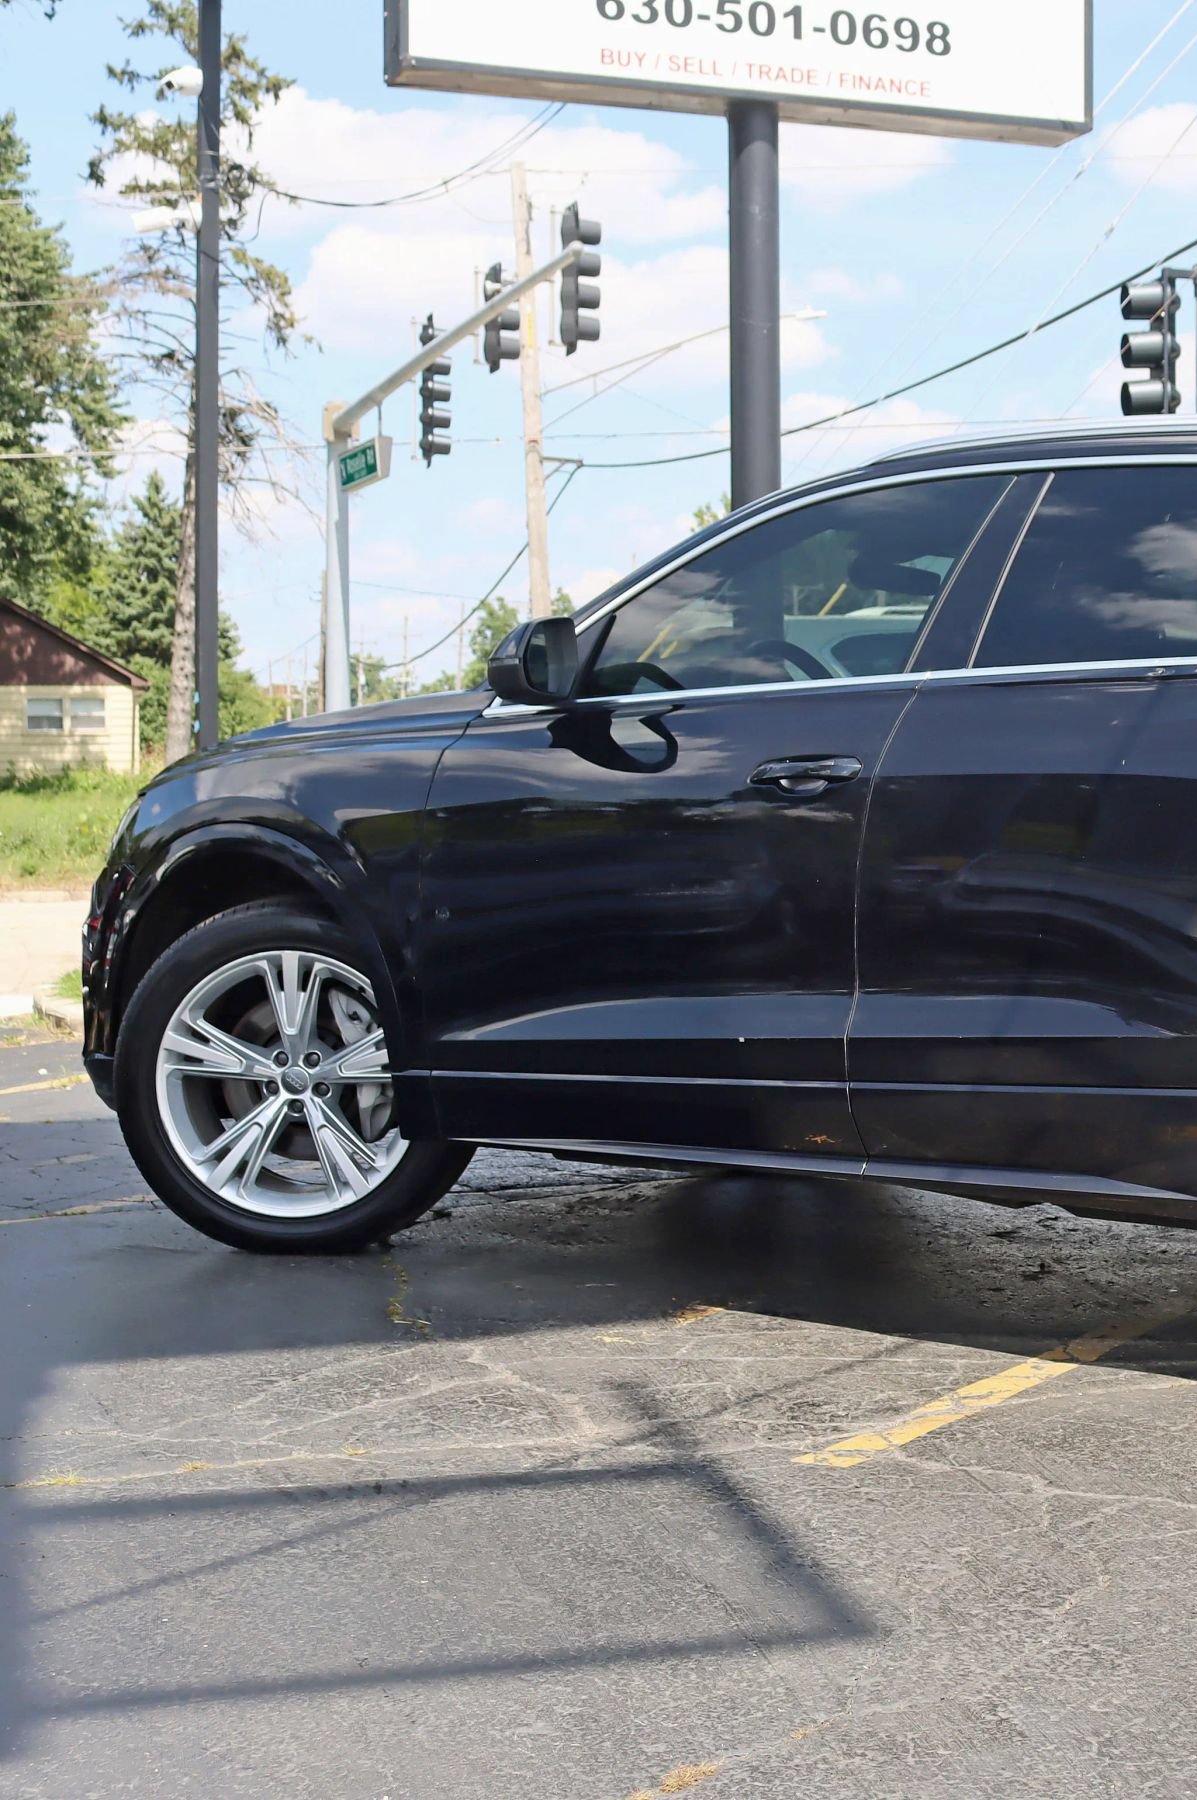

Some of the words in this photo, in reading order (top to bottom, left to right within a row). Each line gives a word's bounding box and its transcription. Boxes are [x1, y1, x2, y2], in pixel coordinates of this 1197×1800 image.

[596, 0, 951, 56] 630-501-0698
[600, 48, 647, 68] BUY
[668, 54, 723, 77] SELL
[745, 62, 818, 86] TRADE
[839, 72, 932, 97] FINANCE
